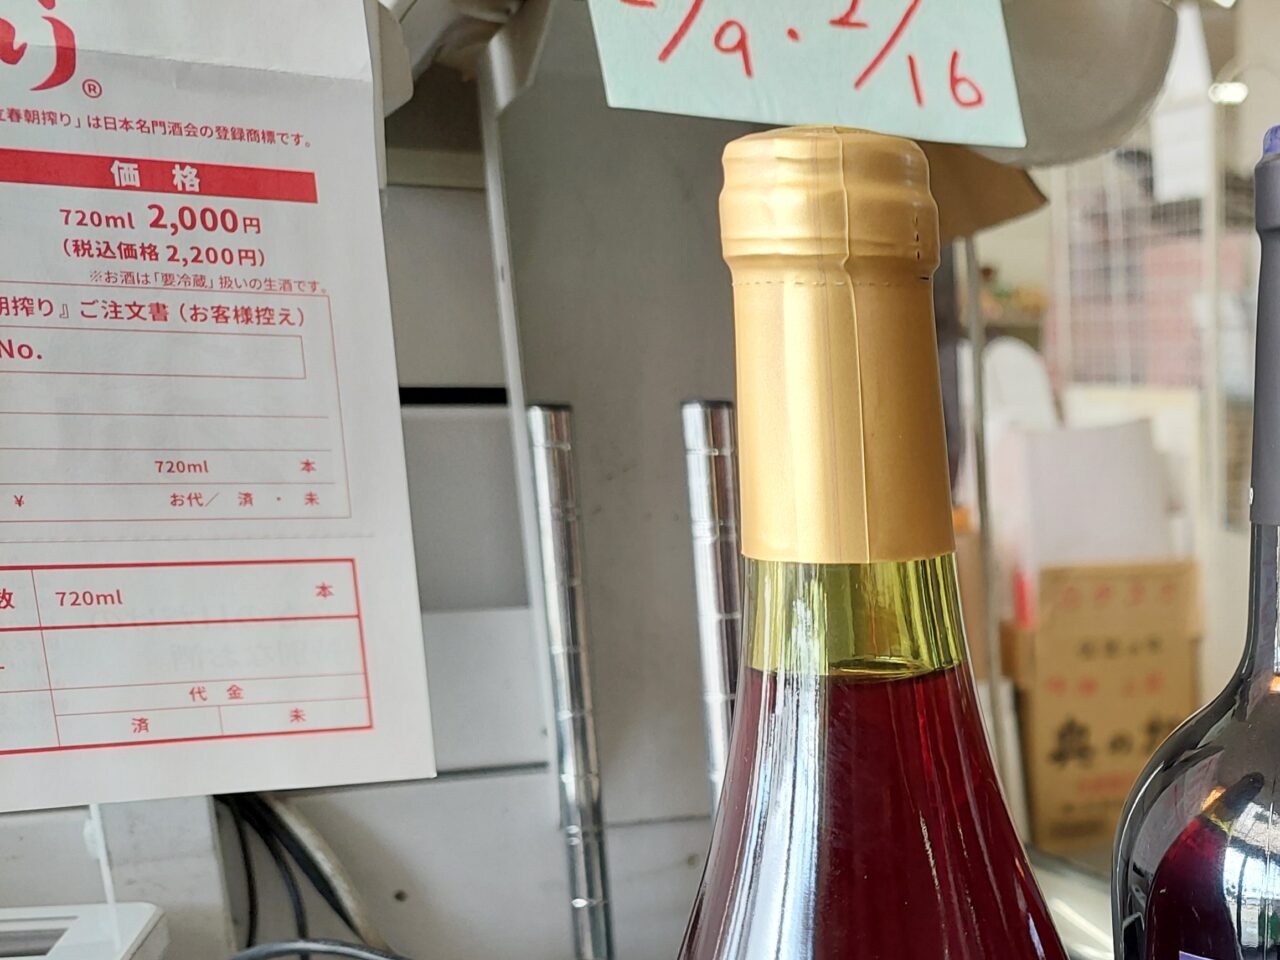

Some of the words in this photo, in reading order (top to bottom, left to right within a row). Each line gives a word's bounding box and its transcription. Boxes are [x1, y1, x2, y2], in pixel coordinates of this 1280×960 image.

[59, 208, 135, 230] 720ml
[155, 460, 209, 474] 720ml
[301, 460, 316, 473] 本
[55, 589, 123, 607] 720ml
[315, 582, 334, 599] 本
